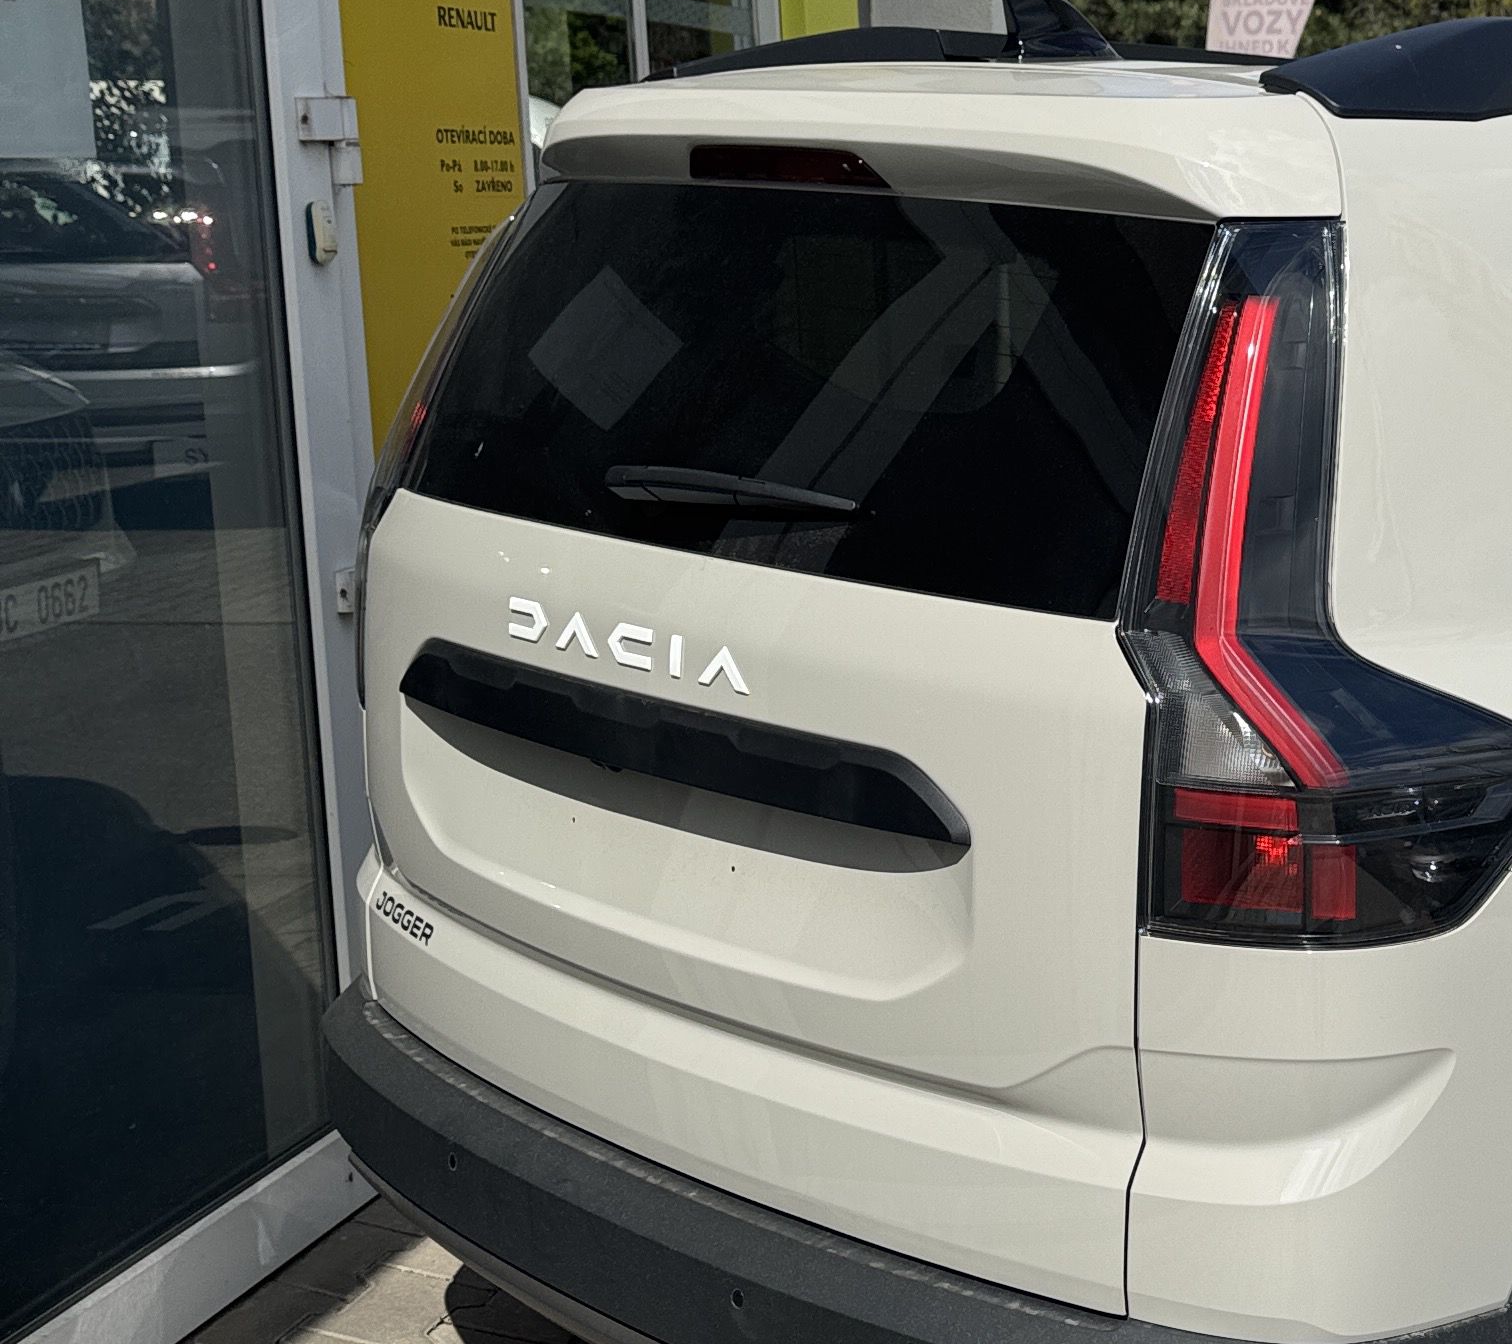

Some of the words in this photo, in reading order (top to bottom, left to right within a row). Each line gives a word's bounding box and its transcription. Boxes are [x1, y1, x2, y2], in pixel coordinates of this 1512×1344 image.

[437, 5, 496, 32] RENAULT
[1221, 9, 1304, 36] VOZY
[436, 125, 487, 145] OTEVÍRACÍ
[488, 129, 515, 146] DOBA
[453, 180, 464, 193] So
[475, 177, 513, 193] ZAVŘENO
[508, 596, 750, 697] DACIA
[376, 890, 434, 947] JOGGER
